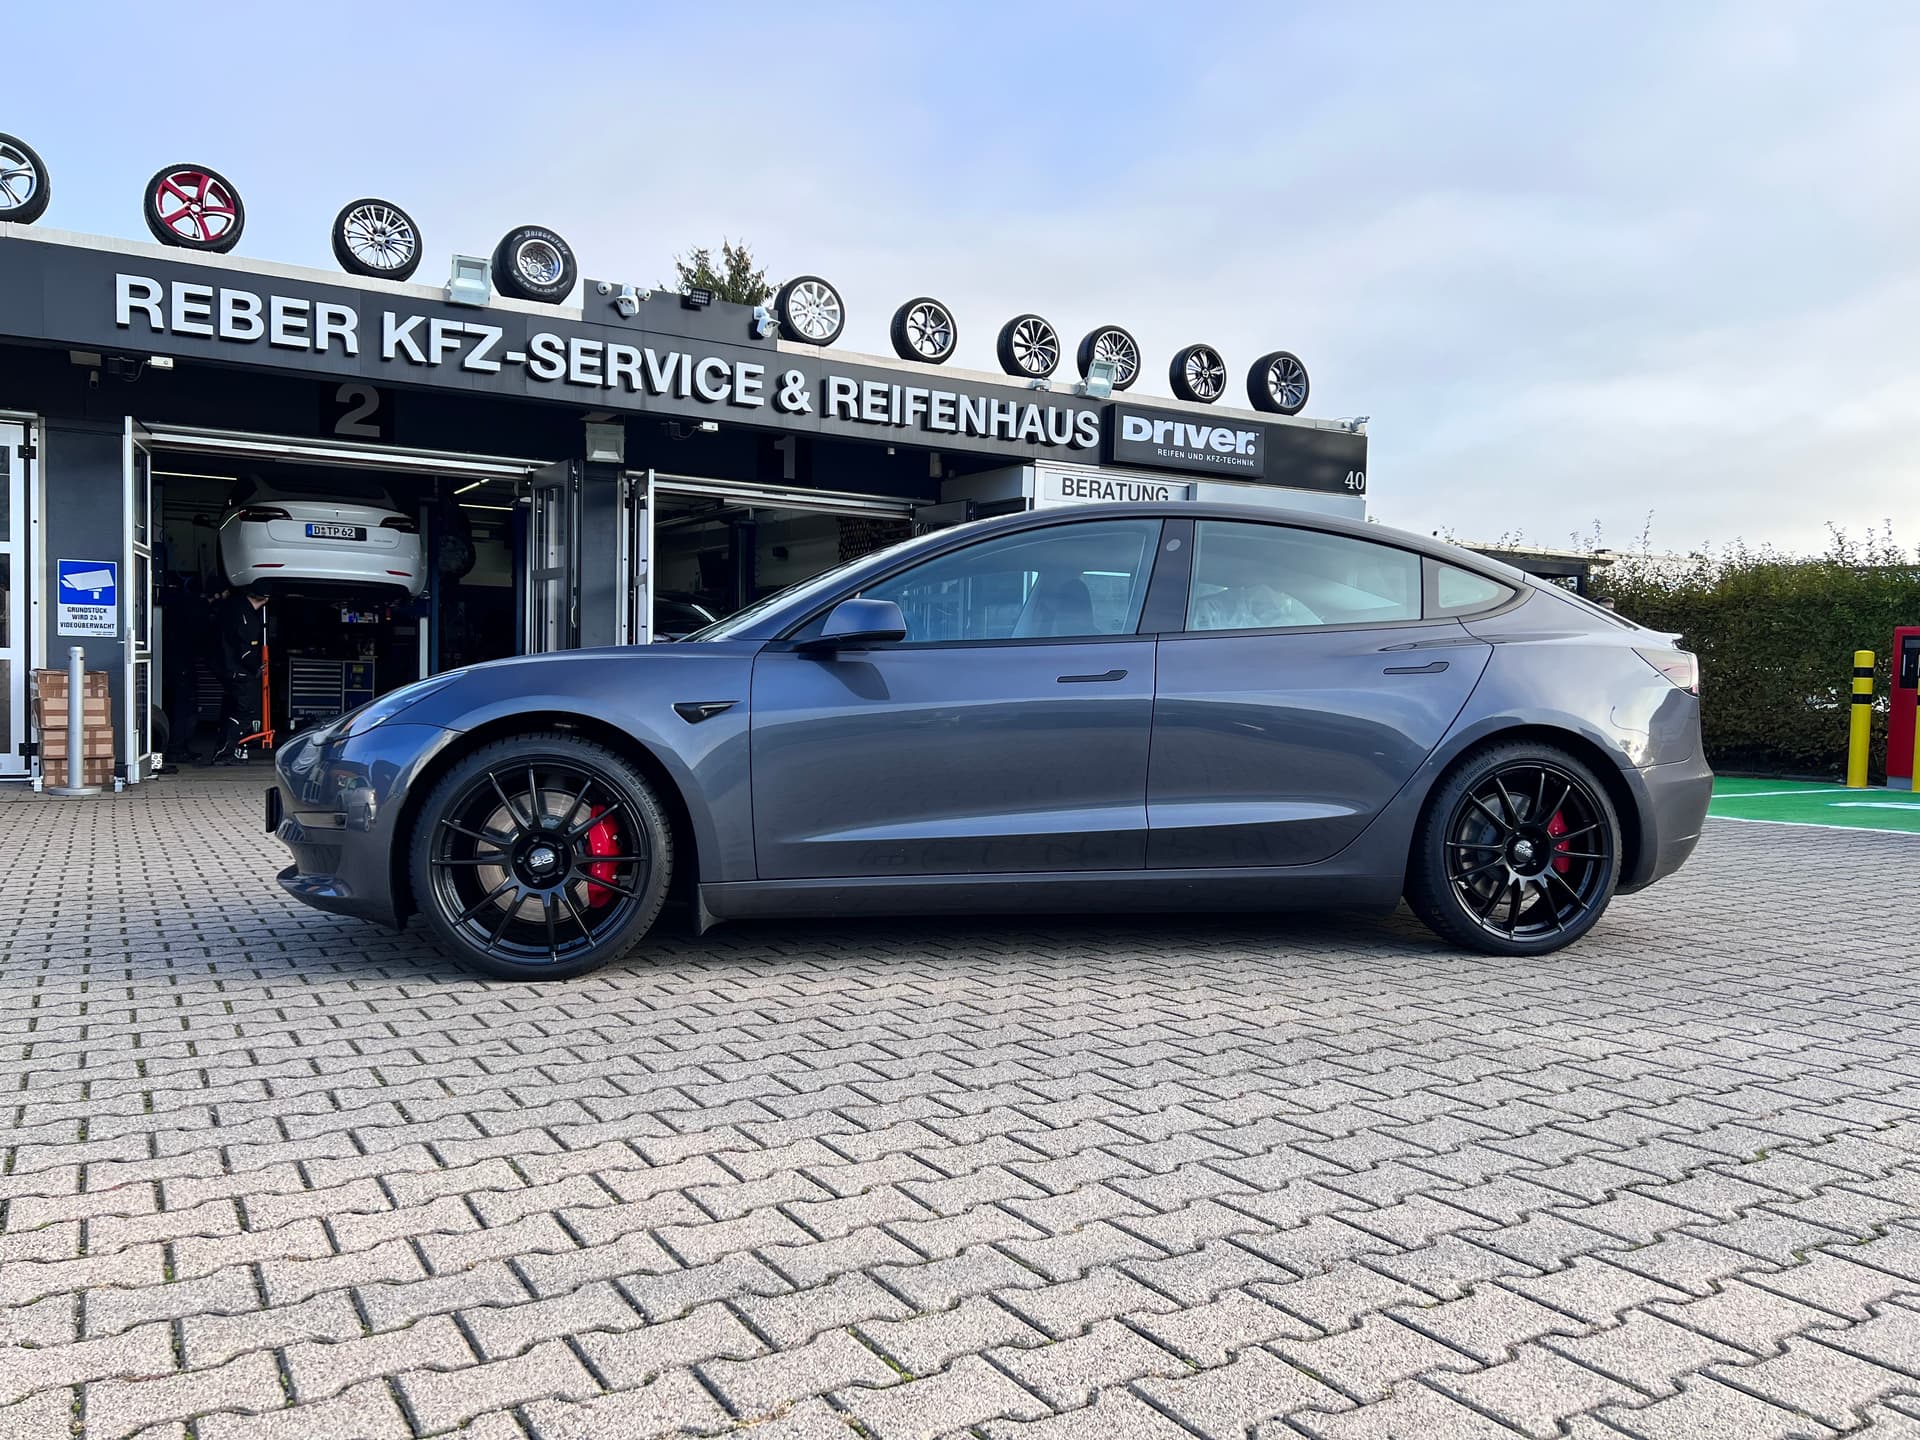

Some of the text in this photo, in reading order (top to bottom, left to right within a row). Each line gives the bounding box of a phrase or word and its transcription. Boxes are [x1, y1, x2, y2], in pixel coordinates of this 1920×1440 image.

[114, 272, 1101, 449] REBER KFZ-SERVICE & REIFENHAUS
[334, 383, 381, 438] 2
[774, 434, 796, 480] 1
[1157, 448, 1255, 467] REIFEN UND KFZ-TECHNIK
[1061, 477, 1169, 501] BERATUNG
[1343, 470, 1365, 490] 40
[313, 525, 354, 537] D TP 62
[67, 606, 107, 614] GRUNDSTÜCK
[60, 621, 115, 630] VIDEOÜBERWACHT
